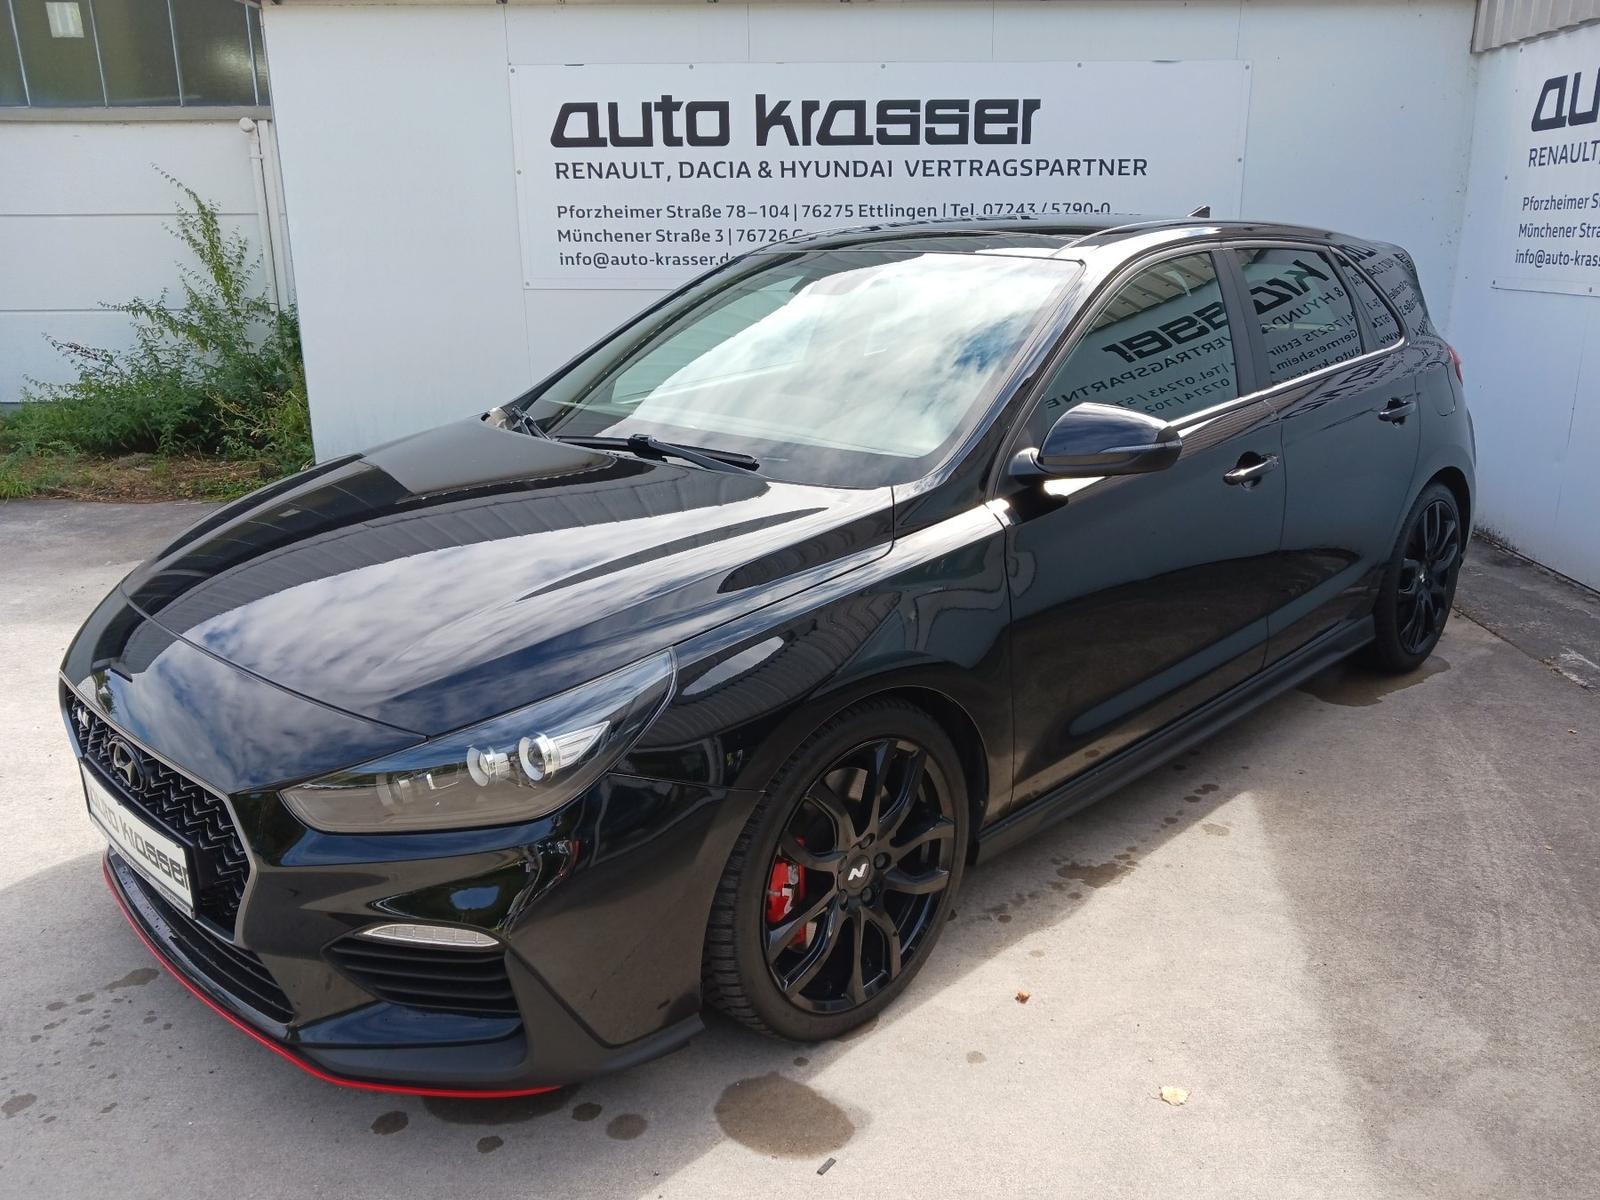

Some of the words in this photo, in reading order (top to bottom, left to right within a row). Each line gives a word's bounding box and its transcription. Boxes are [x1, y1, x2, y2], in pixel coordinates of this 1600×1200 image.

[550, 95, 730, 148] auto
[755, 94, 1041, 147] krasser
[554, 161, 672, 183] RENAULT,
[678, 161, 751, 179] DACIA
[758, 160, 773, 178] &
[780, 159, 893, 179] HYUNDAI
[904, 158, 1148, 178] VERTRAGSPARTNER
[557, 204, 663, 220] Pforzheimer
[666, 204, 722, 219] Straße
[801, 204, 854, 218] 76275
[858, 203, 938, 220] Ettlingen
[950, 203, 979, 217] Tel.
[983, 202, 1036, 215] 07243
[1522, 194, 1589, 212] Pforzheimer
[557, 228, 651, 243] Münchener
[655, 228, 711, 243] Straße
[714, 229, 724, 243] 3
[736, 229, 788, 243] 76726
[1518, 222, 1578, 239] Münchener
